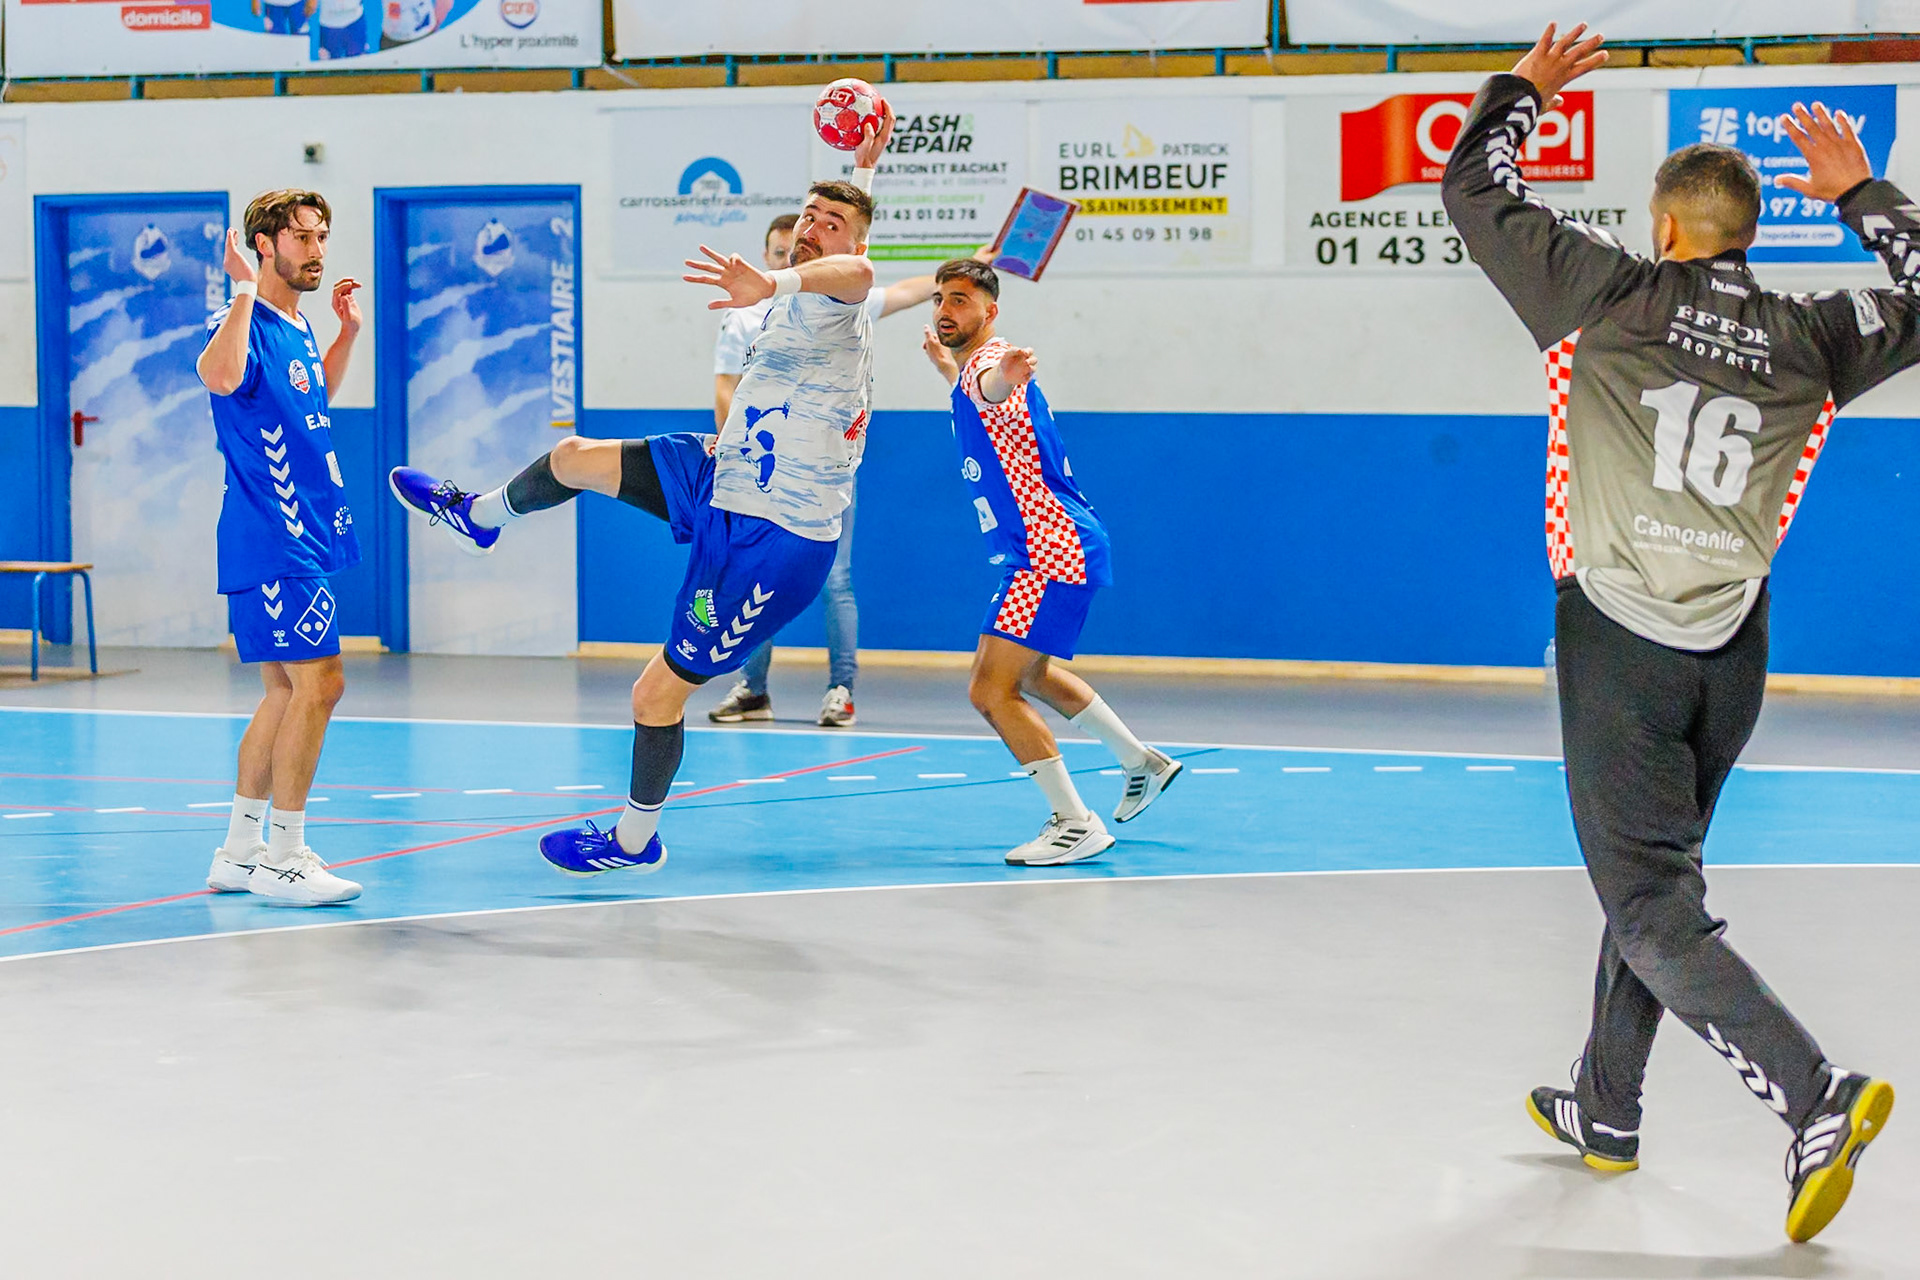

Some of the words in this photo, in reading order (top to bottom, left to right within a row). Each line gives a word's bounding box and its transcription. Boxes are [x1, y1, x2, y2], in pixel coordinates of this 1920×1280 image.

[124, 9, 203, 26] domicile
[1416, 100, 1585, 164] OPI
[887, 135, 973, 153] REPAIR
[1059, 143, 1116, 158] EURL
[1163, 143, 1229, 156] PATRICK
[931, 163, 946, 174] ET
[950, 162, 1008, 174] RACHAT
[1060, 164, 1228, 190] BRIMBEUF
[917, 209, 932, 220] 01
[1769, 197, 1797, 217] 97
[552, 216, 574, 239] 2
[1310, 210, 1408, 228] AGENCE
[205, 222, 224, 241] 3
[1075, 229, 1094, 241] 01
[1102, 228, 1124, 241] 45
[1132, 228, 1155, 241] 09
[1163, 228, 1181, 240] 31
[1189, 228, 1212, 241] 98
[1316, 236, 1358, 265] 01
[1378, 236, 1426, 265] 43
[1442, 236, 1478, 264] 3
[551, 260, 575, 418] VESTIAIRE
[1639, 380, 1763, 507] 16
[1633, 514, 1745, 554] Campanile
